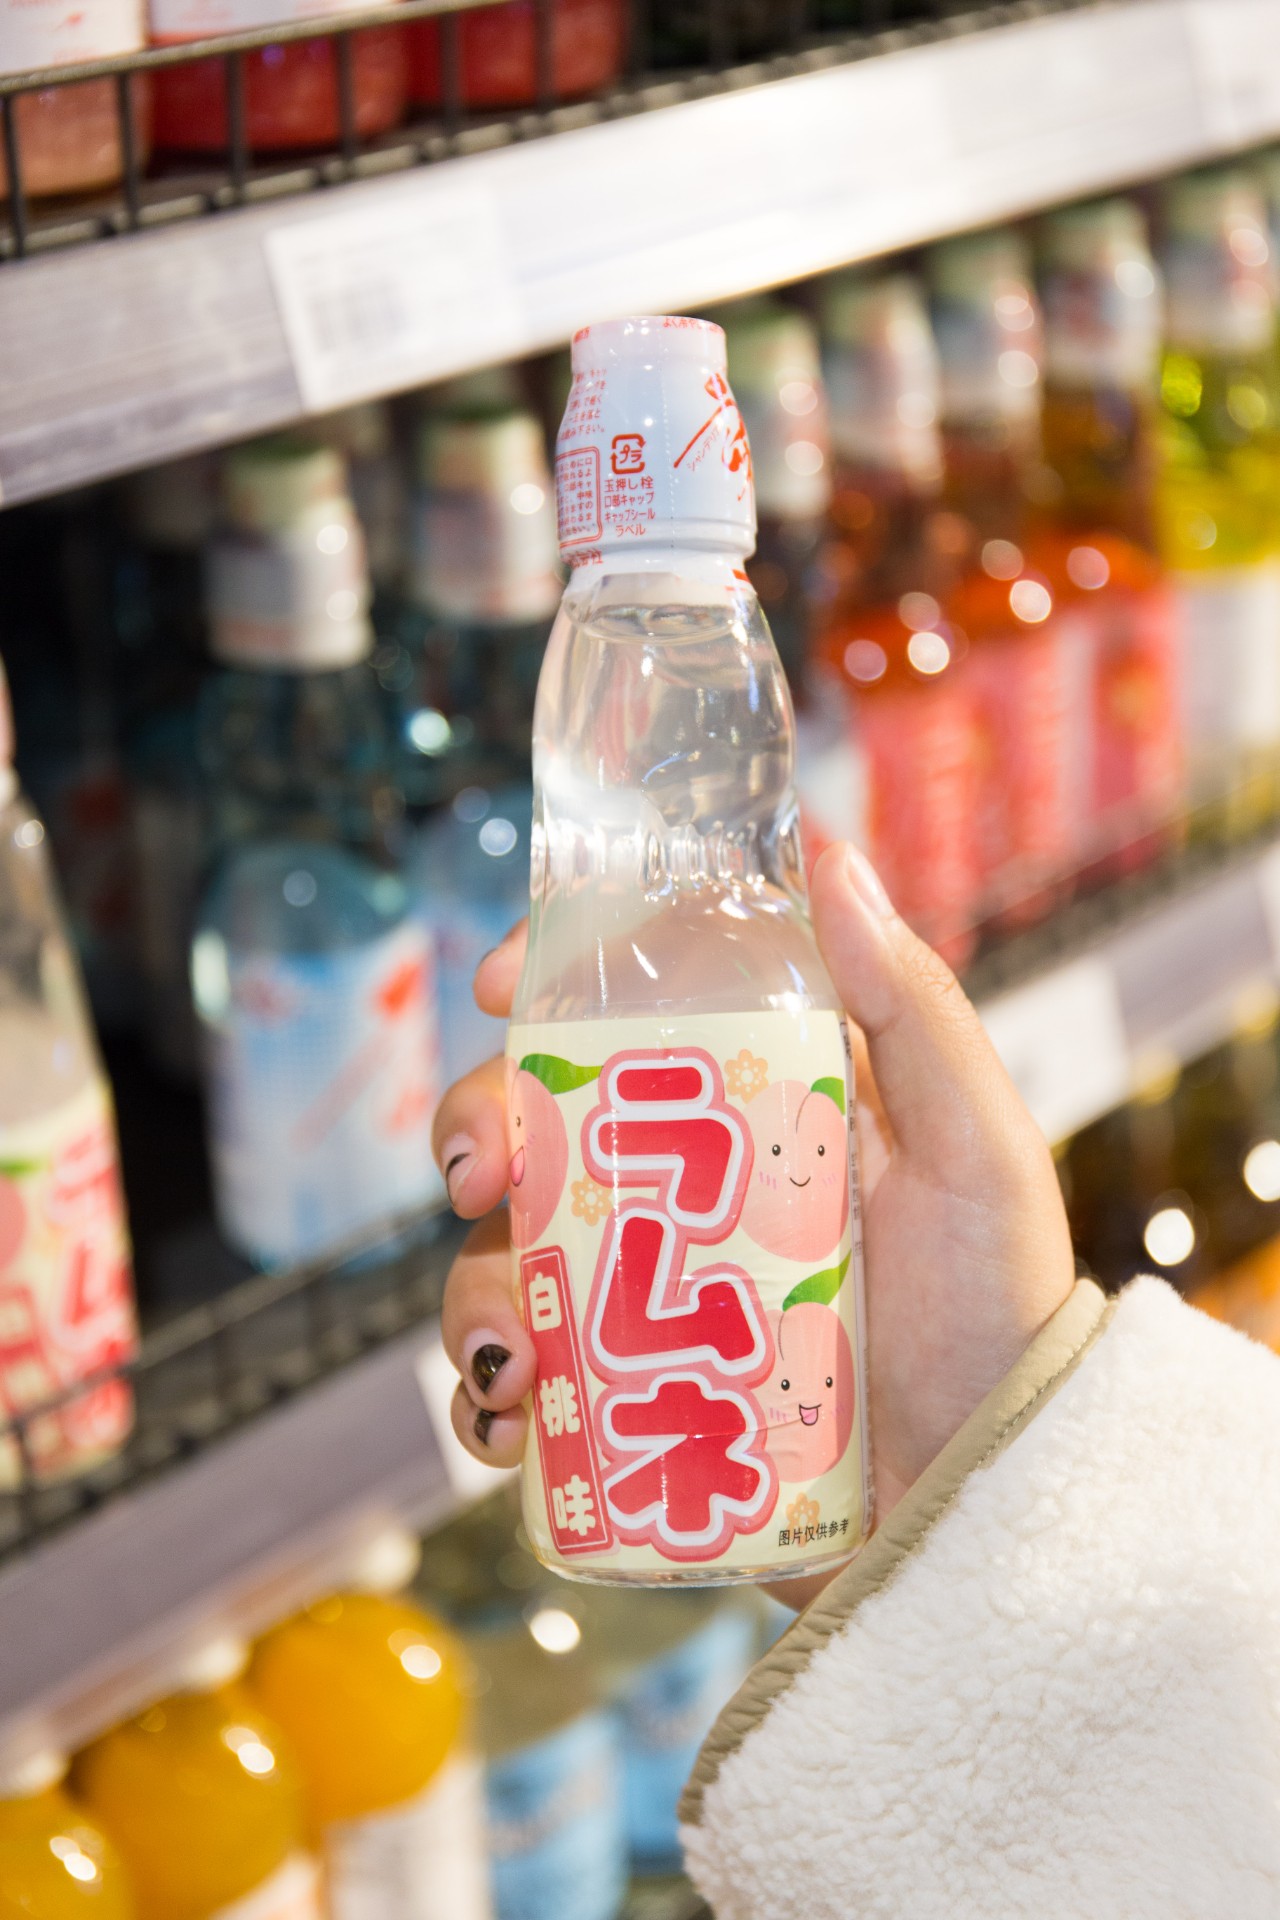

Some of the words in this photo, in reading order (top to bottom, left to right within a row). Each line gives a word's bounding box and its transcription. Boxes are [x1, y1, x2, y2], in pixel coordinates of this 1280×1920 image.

[619, 443, 643, 464] プラ
[604, 475, 654, 493] 玉押し栓
[604, 491, 655, 508] 口部キャップ
[604, 507, 656, 524] キャップシール
[615, 523, 646, 538] ラベル
[588, 1057, 772, 1548] ラムネ
[528, 1272, 597, 1537] 白桃味
[778, 1518, 849, 1547] 图片仅供参考
